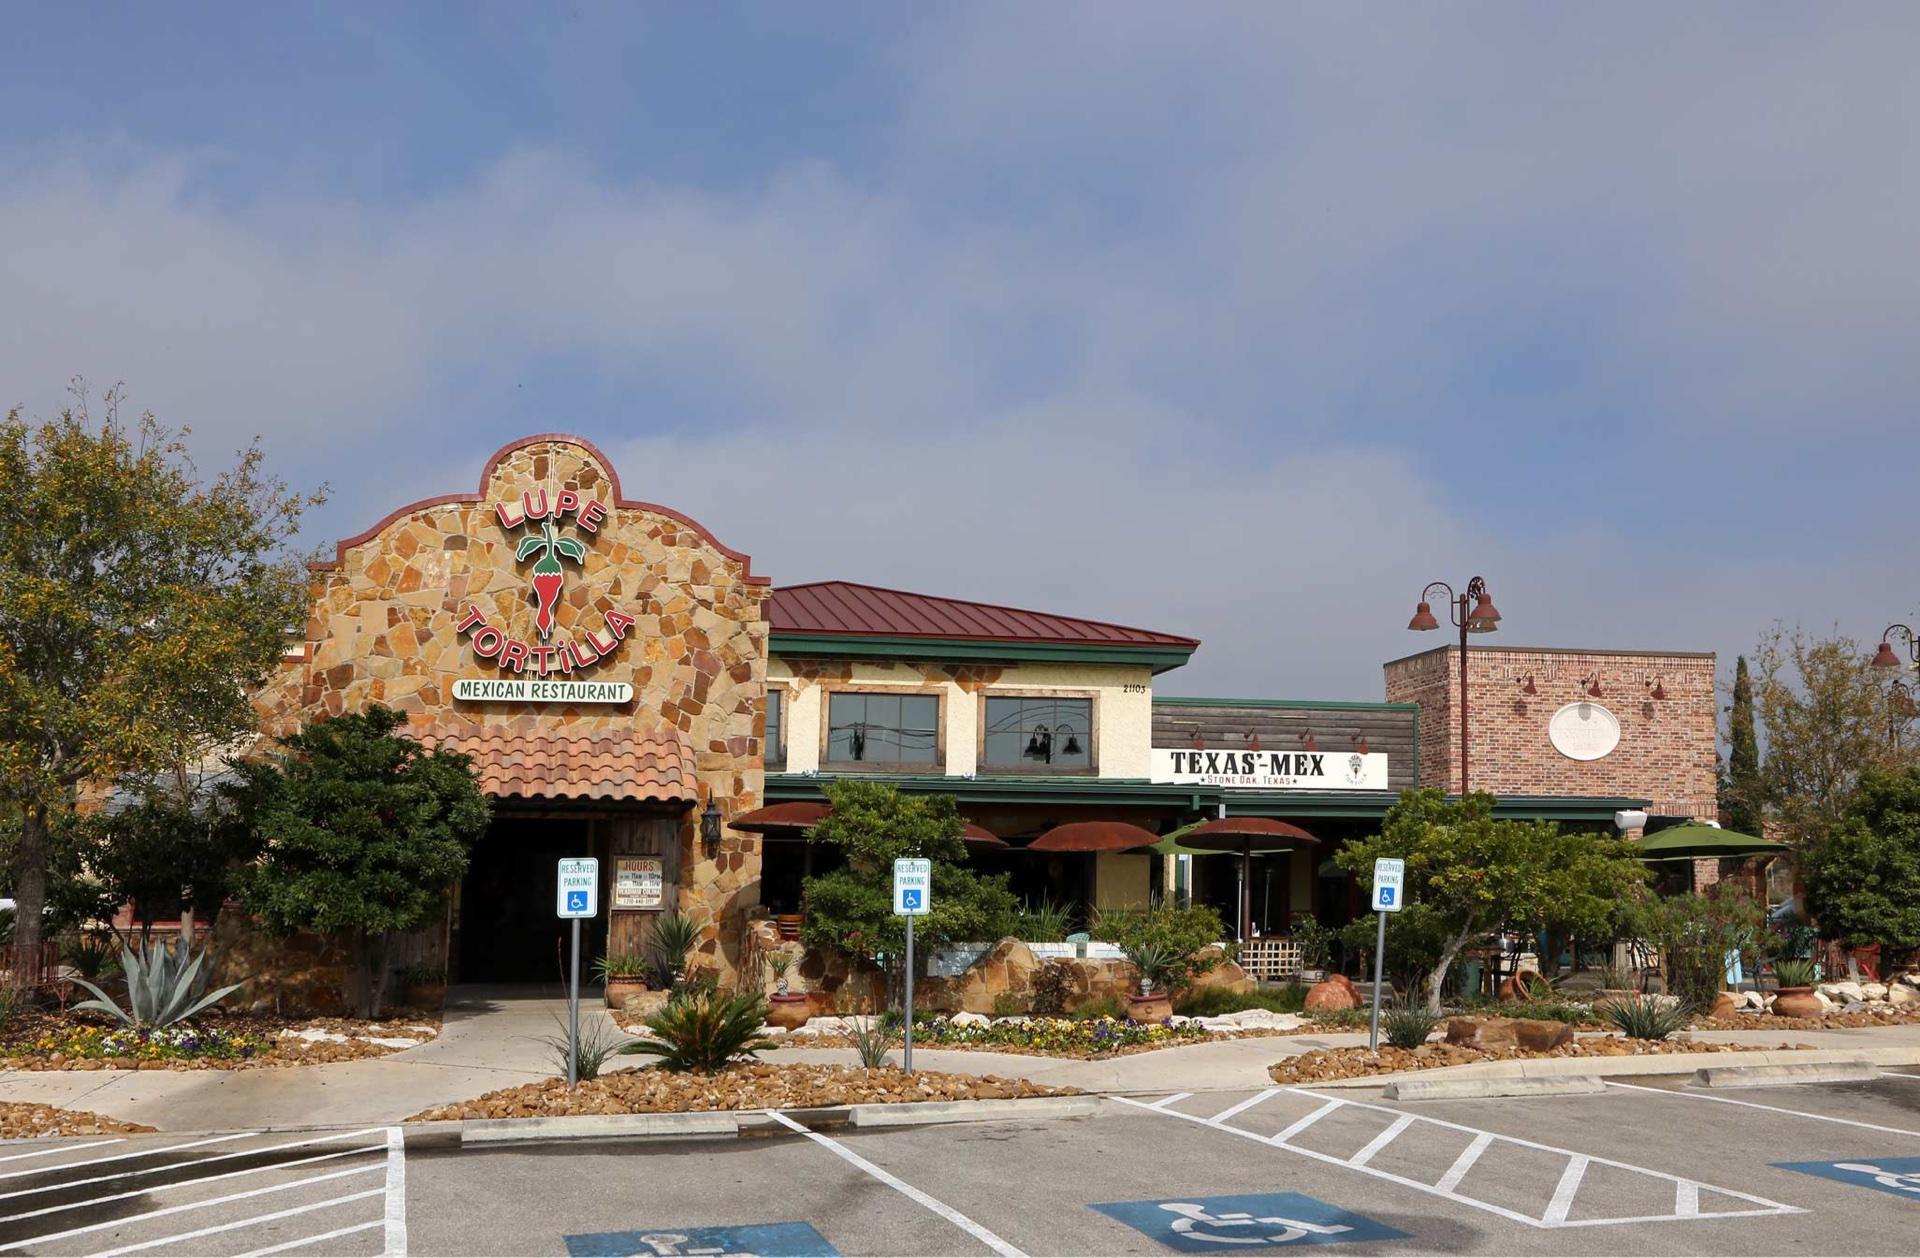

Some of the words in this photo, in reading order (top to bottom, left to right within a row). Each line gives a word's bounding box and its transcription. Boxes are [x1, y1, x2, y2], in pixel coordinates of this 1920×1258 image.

[495, 489, 608, 533] LUPE
[460, 681, 525, 698] MEXICAN
[531, 682, 626, 700] RESTAURANT
[1123, 684, 1146, 694] 21103
[562, 864, 595, 874] RESERVED
[625, 861, 654, 871] HOURS
[897, 864, 927, 873] RESERVED
[563, 877, 592, 887] PARKING
[899, 877, 925, 885] PARKING
